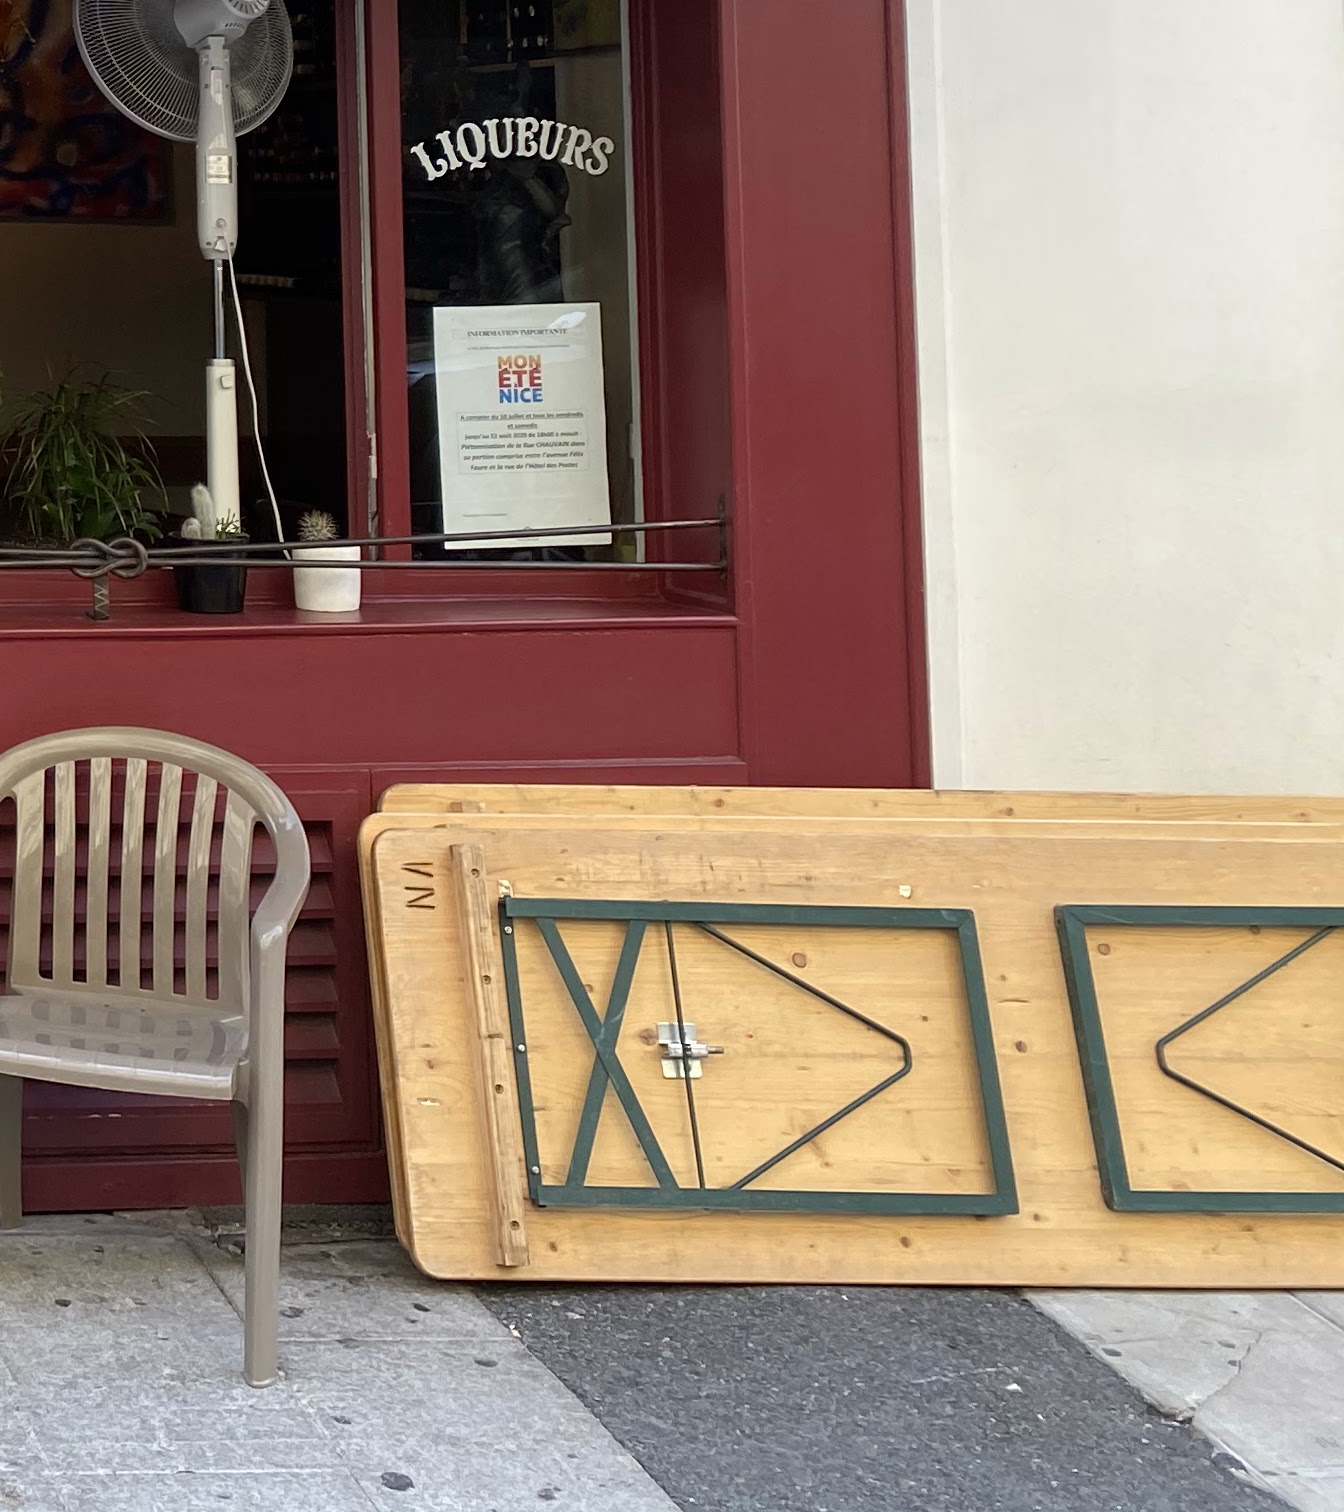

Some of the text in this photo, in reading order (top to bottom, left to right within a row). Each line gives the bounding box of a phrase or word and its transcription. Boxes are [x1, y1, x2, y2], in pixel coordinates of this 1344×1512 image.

[411, 117, 614, 181] LIQUEURS
[497, 354, 541, 368] MON
[500, 388, 543, 403] NICE
